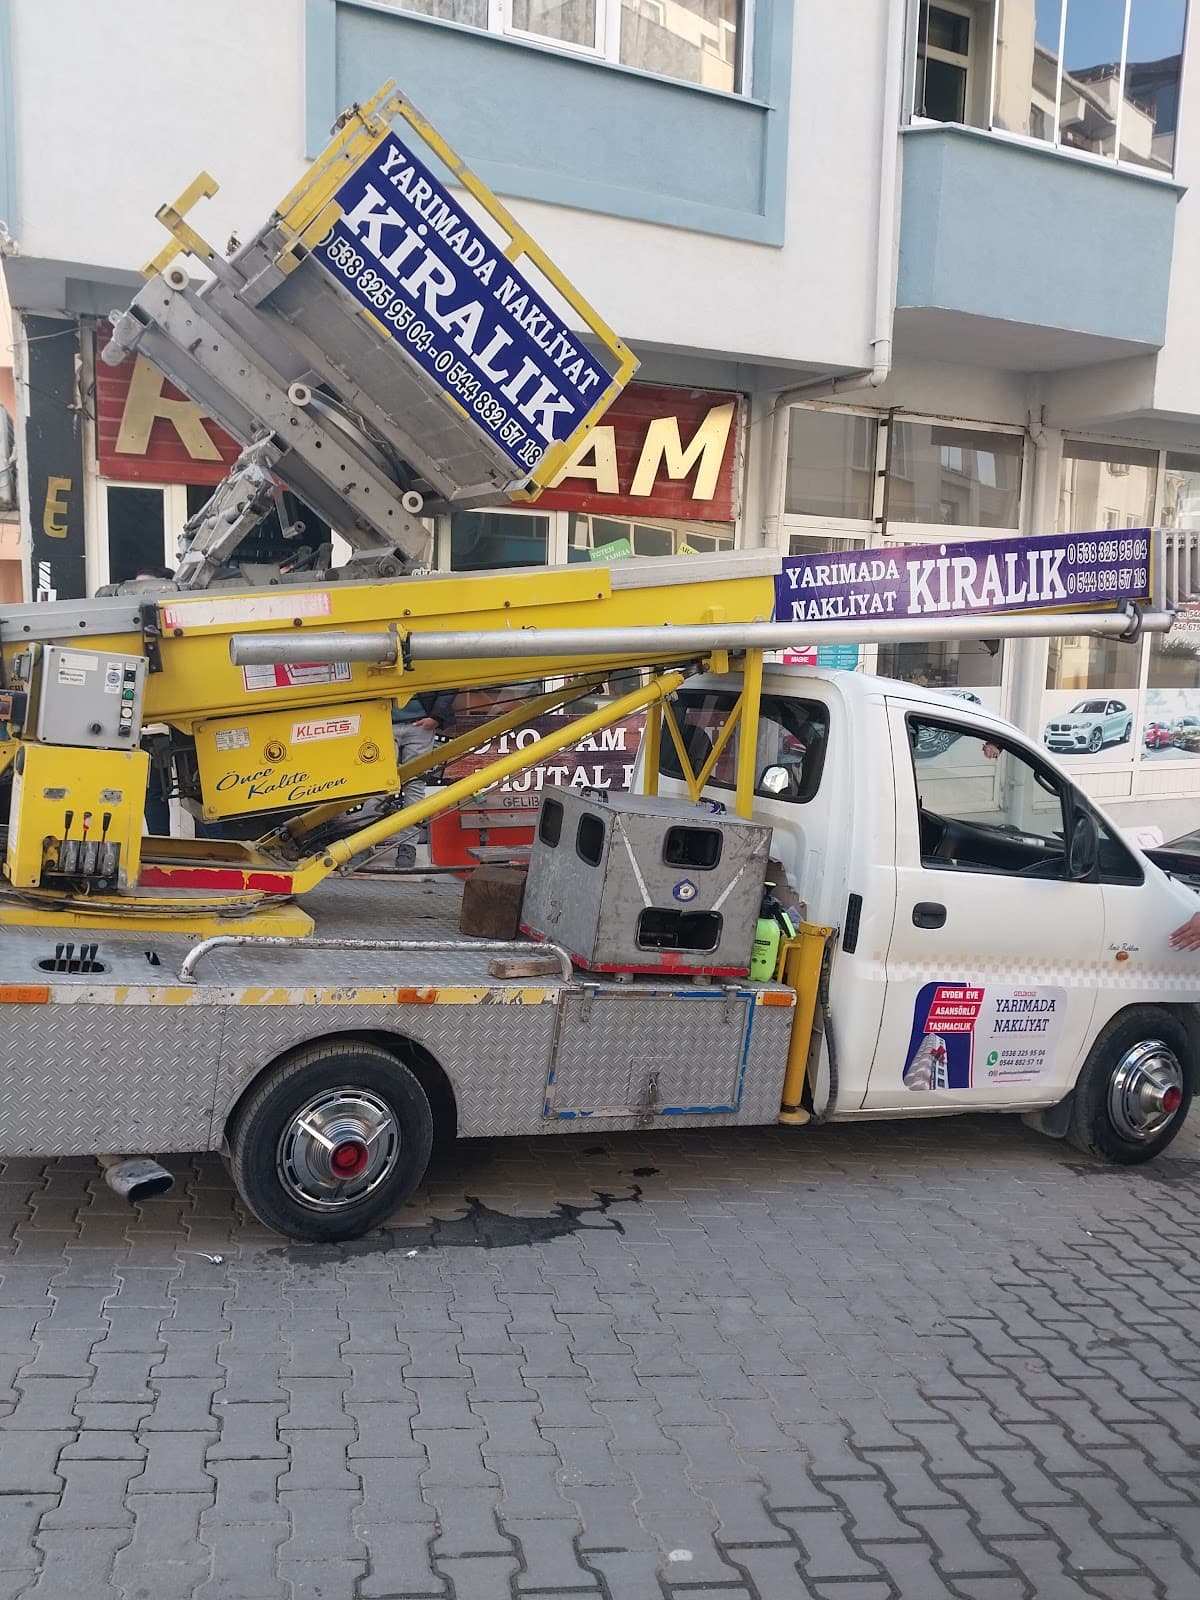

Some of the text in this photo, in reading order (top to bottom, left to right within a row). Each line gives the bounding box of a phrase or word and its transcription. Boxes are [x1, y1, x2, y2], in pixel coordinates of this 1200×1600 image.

[379, 144, 600, 395] YARIMADA NAKLİYAT
[345, 183, 575, 442] KİRALIK
[327, 236, 364, 278] 538
[357, 269, 396, 308] 325
[384, 299, 416, 330] 95
[447, 361, 481, 401] 544
[474, 391, 506, 430] 882
[500, 418, 527, 447] 57
[517, 439, 543, 467] 18
[1067, 539, 1148, 564] 0 538 325 95 04
[786, 560, 900, 589] YARIMADA
[907, 544, 1068, 614] KİRALIK
[1067, 568, 1147, 594] 0 544 882 57 18
[791, 590, 897, 621] NAKLİYAT
[216, 768, 275, 791] Önce
[247, 772, 310, 800] Kalite
[287, 777, 347, 801] Güven
[475, 764, 611, 792] JİTAL
[941, 990, 979, 999] EVDEN EVE
[996, 999, 1056, 1012] YARIMADA
[935, 1005, 976, 1015] ASANSÖRLÜ
[929, 1022, 972, 1031] TAŞIMACILIK
[993, 1016, 1049, 1032] NAKLİYAT
